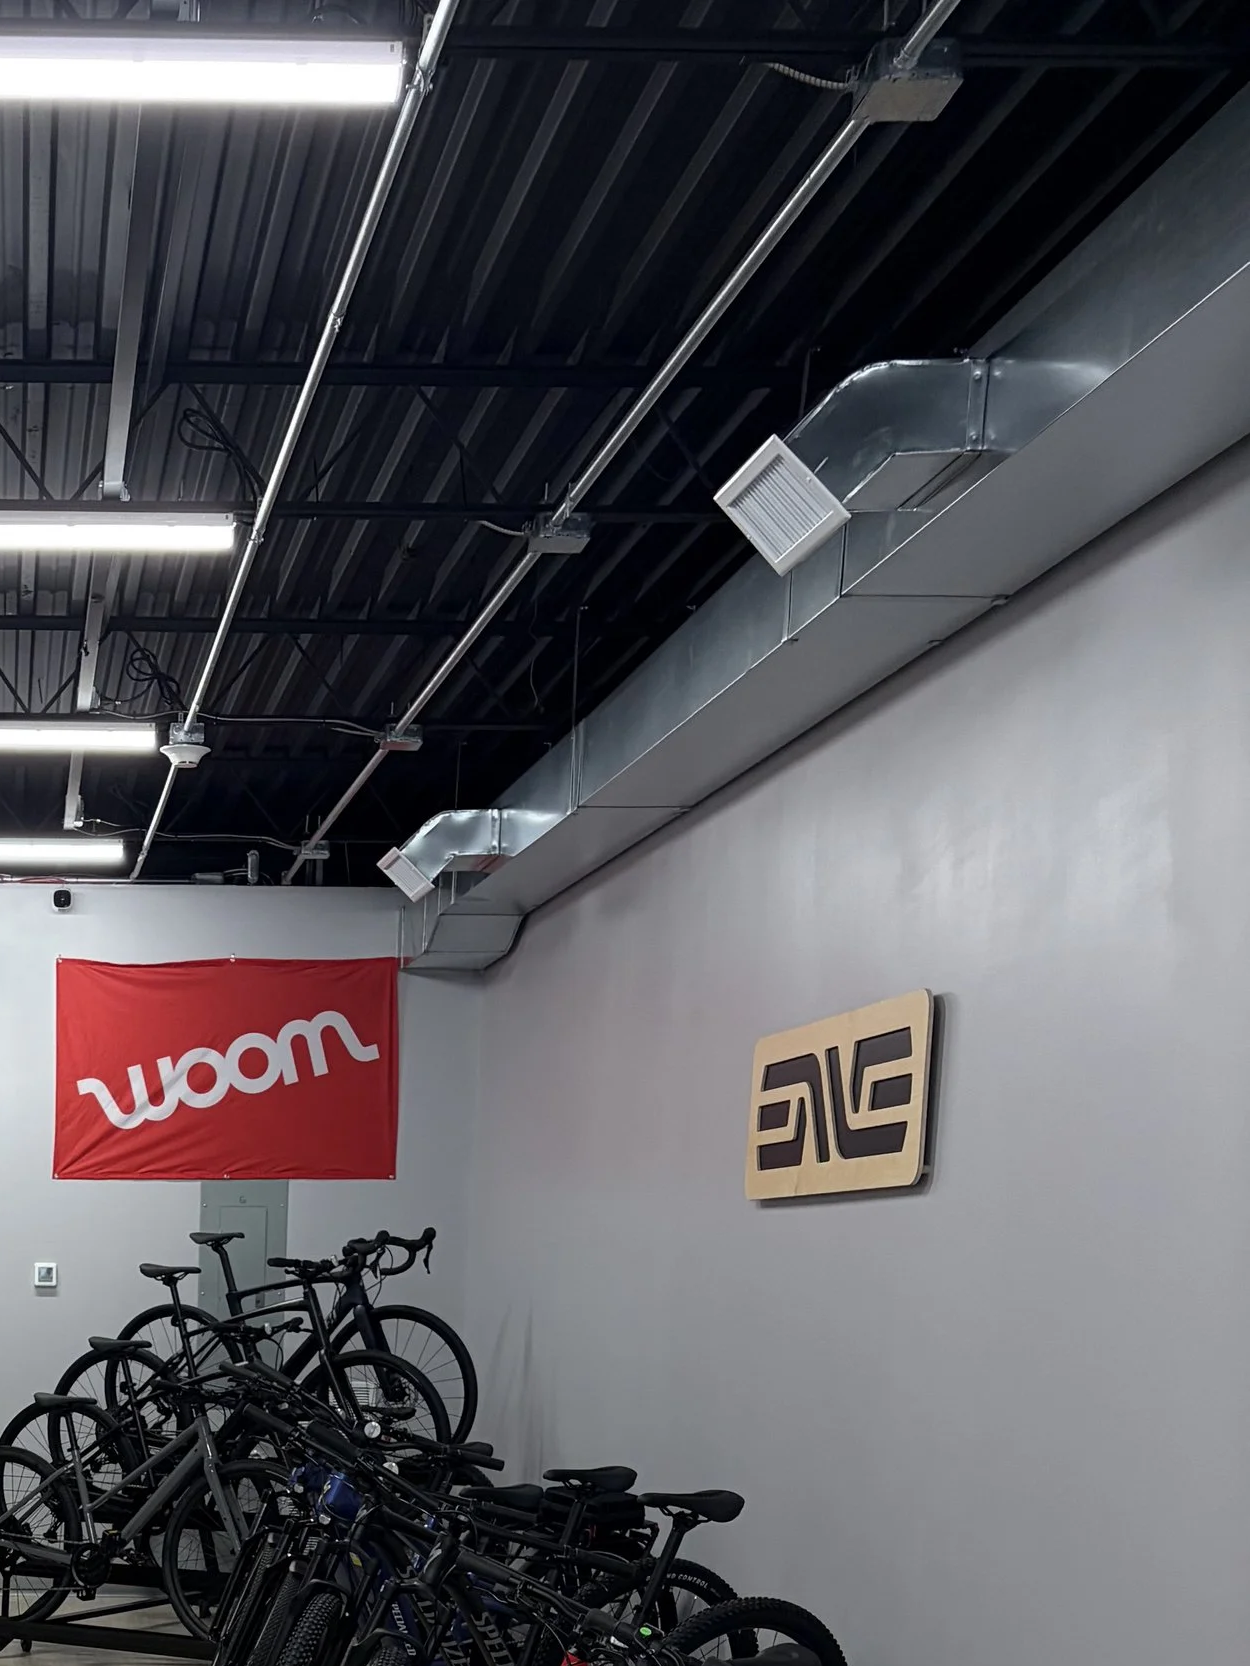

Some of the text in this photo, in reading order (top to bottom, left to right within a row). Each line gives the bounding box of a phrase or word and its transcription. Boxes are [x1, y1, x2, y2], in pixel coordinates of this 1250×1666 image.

[77, 1009, 381, 1131] woom
[756, 1026, 913, 1172] ENVE
[677, 1573, 710, 1590] CONTROL
